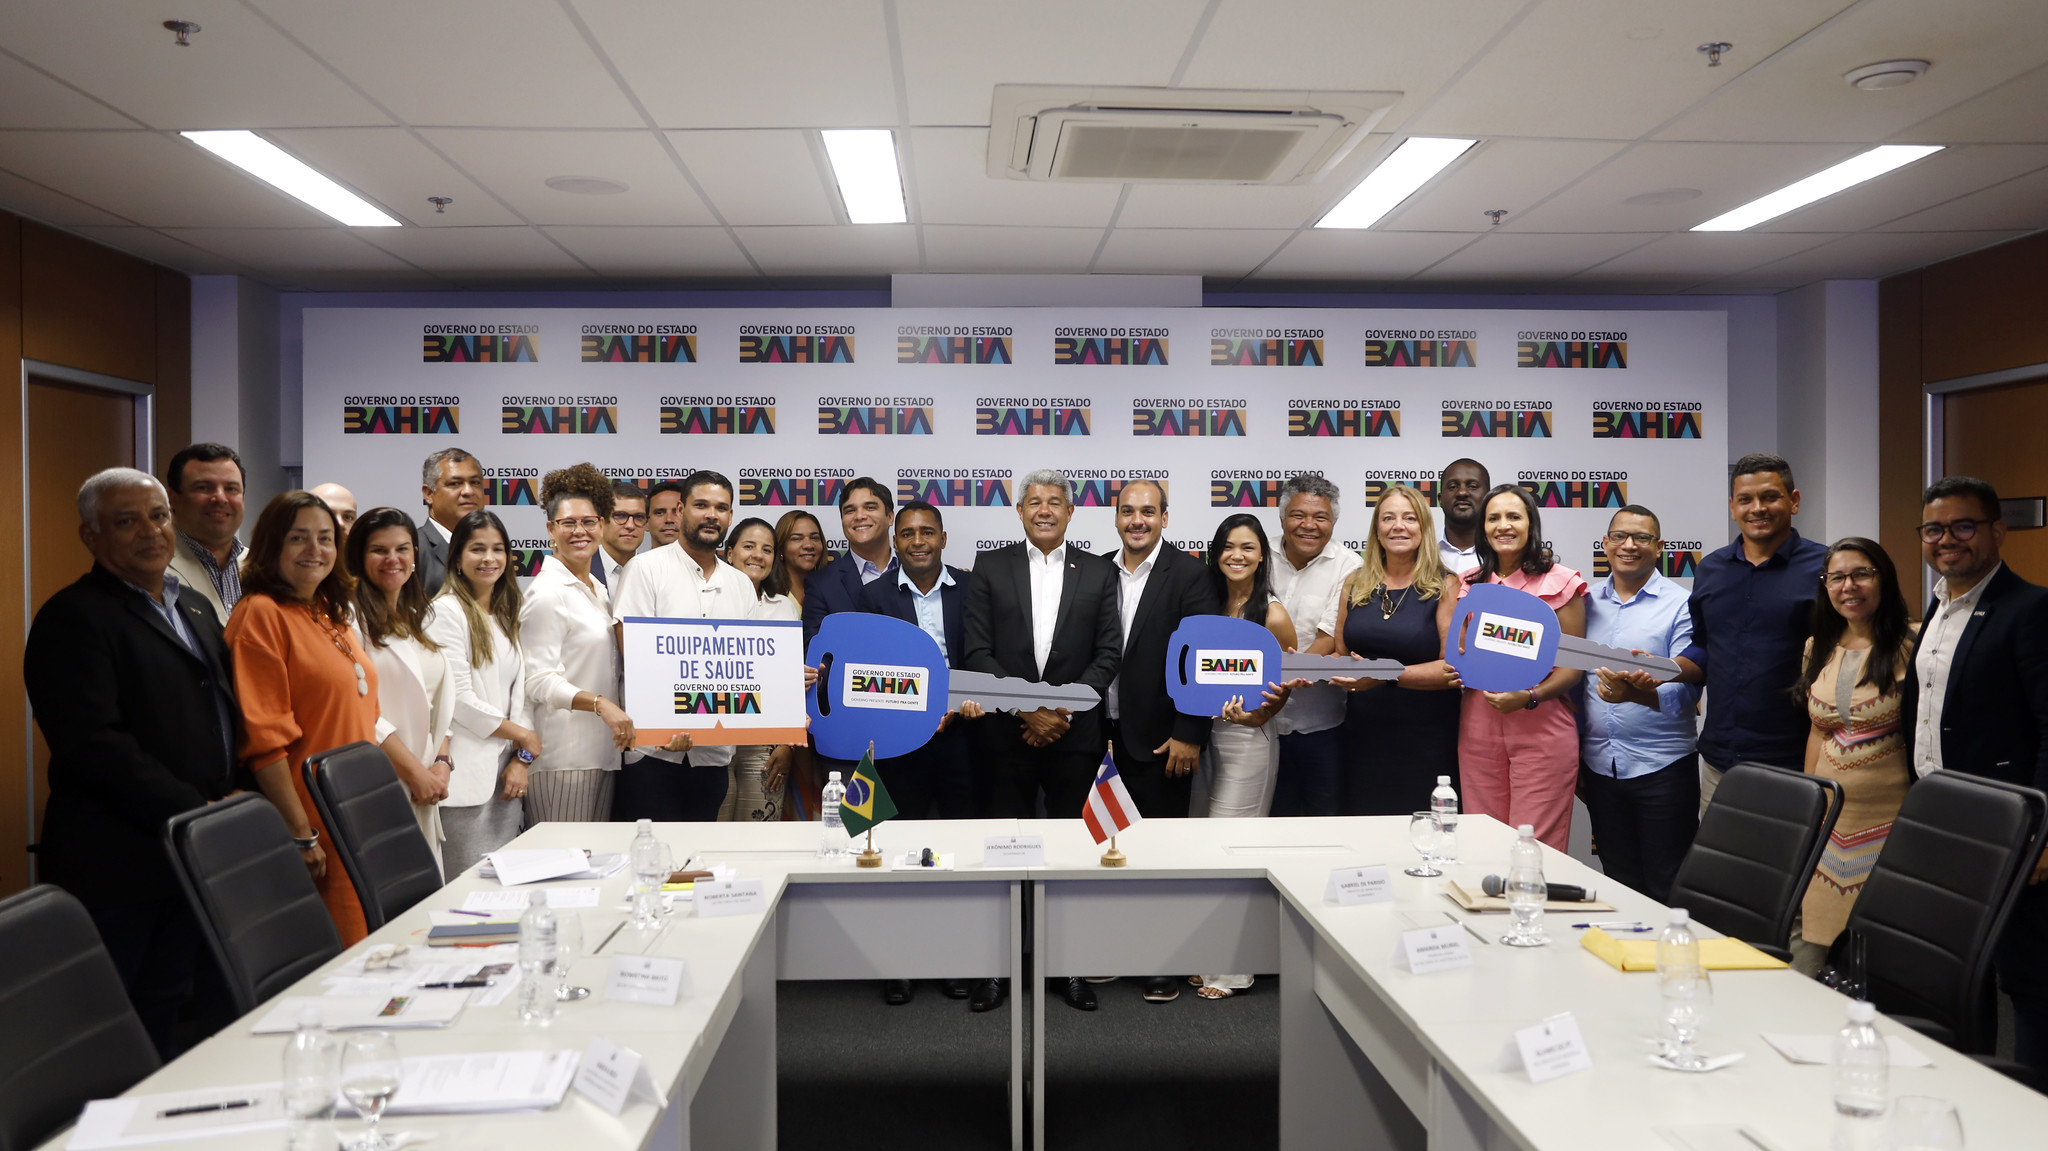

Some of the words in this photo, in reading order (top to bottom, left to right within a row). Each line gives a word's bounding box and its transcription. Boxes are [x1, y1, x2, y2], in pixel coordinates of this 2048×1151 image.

[424, 325, 477, 335] GOVERNO
[480, 325, 495, 335] DO
[498, 325, 538, 335] ESTADO
[582, 325, 635, 335] GOVERNO
[638, 325, 653, 335] DO
[657, 325, 697, 335] ESTADO
[740, 325, 793, 335] GOVERNO
[796, 325, 811, 335] DO
[815, 325, 855, 335] ESTADO
[898, 326, 950, 336] GOVERNO
[954, 326, 969, 336] DO
[972, 326, 1012, 336] ESTADO
[1055, 328, 1107, 338] GOVERNO
[1111, 328, 1126, 338] DO
[1129, 328, 1169, 338] ESTADO
[1211, 329, 1263, 338] GOVERNO
[1266, 329, 1281, 338] DO
[1284, 329, 1324, 339] ESTADO
[1365, 330, 1417, 340] GOVERNO
[1420, 330, 1434, 340] DO
[1438, 330, 1477, 340] ESTADO
[1518, 331, 1568, 341] GOVERNO
[1571, 331, 1586, 341] DO
[1589, 331, 1628, 341] ESTADO
[424, 335, 538, 362] BAHIA
[582, 335, 697, 362] BAHIA
[740, 335, 855, 363] BAHIA
[898, 336, 1012, 364] BAHIA
[1055, 337, 1169, 365] BAHIA
[1211, 339, 1324, 366] BAHIA
[1365, 340, 1477, 367] BAHIA
[1518, 341, 1628, 368] BAHIA
[344, 396, 397, 406] GOVERNO
[401, 396, 416, 406] DO
[419, 396, 459, 406] ESTADO
[502, 396, 555, 406] GOVERNO
[559, 396, 574, 406] DO
[577, 396, 617, 406] ESTADO
[660, 396, 713, 406] GOVERNO
[716, 396, 732, 406] DO
[735, 396, 775, 406] ESTADO
[818, 397, 871, 407] GOVERNO
[875, 397, 890, 407] DO
[893, 397, 933, 407] ESTADO
[976, 398, 1029, 407] GOVERNO
[1032, 398, 1047, 407] DO
[1051, 398, 1091, 408] ESTADO
[1133, 399, 1185, 408] GOVERNO
[1189, 399, 1203, 408] DO
[1207, 399, 1246, 409] ESTADO
[1288, 400, 1340, 410] GOVERNO
[1343, 400, 1358, 410] DO
[1361, 400, 1400, 410] ESTADO
[1442, 401, 1493, 411] GOVERNO
[1496, 401, 1510, 411] DO
[1514, 401, 1552, 411] ESTADO
[1593, 402, 1643, 412] GOVERNO
[1646, 402, 1661, 412] DO
[1664, 402, 1702, 412] ESTADO
[344, 406, 459, 434] BAHIA
[502, 406, 617, 434] BAHIA
[660, 406, 775, 434] BAHIA
[818, 407, 933, 434] BAHIA
[976, 408, 1091, 435] BAHIA
[1133, 409, 1246, 436] BAHIA
[1288, 410, 1400, 437] BAHIA
[1442, 411, 1552, 438] BAHIA
[1593, 412, 1702, 439] BAHIA
[498, 468, 538, 477] ESTADO
[638, 468, 653, 477] DO
[739, 468, 792, 478] GOVERNO
[796, 468, 811, 478] DO
[814, 468, 855, 478] ESTADO
[897, 469, 950, 478] GOVERNO
[954, 469, 969, 478] DO
[972, 469, 1012, 478] ESTADO
[1111, 470, 1126, 479] DO
[1129, 470, 1169, 479] ESTADO
[1211, 470, 1263, 479] GOVERNO
[1266, 470, 1281, 479] DO
[1365, 470, 1417, 479] GOVERNO
[1420, 470, 1434, 479] DO
[1518, 471, 1569, 480] GOVERNO
[1572, 471, 1586, 480] DO
[1589, 471, 1628, 480] ESTADO
[897, 479, 1012, 506] BAHIA
[1189, 541, 1203, 549] DO
[1344, 541, 1358, 549] DO
[1664, 541, 1702, 550] ESTADO
[1482, 622, 1536, 646] BAHIA
[656, 636, 776, 656] EQUIPAMENTOS
[680, 660, 699, 679] DE
[705, 658, 754, 679] SAÚDE
[1202, 659, 1257, 672] BAHIA
[853, 669, 884, 677] GOVERNO
[852, 676, 920, 695] BAHIA
[674, 692, 761, 714] BAHIA
